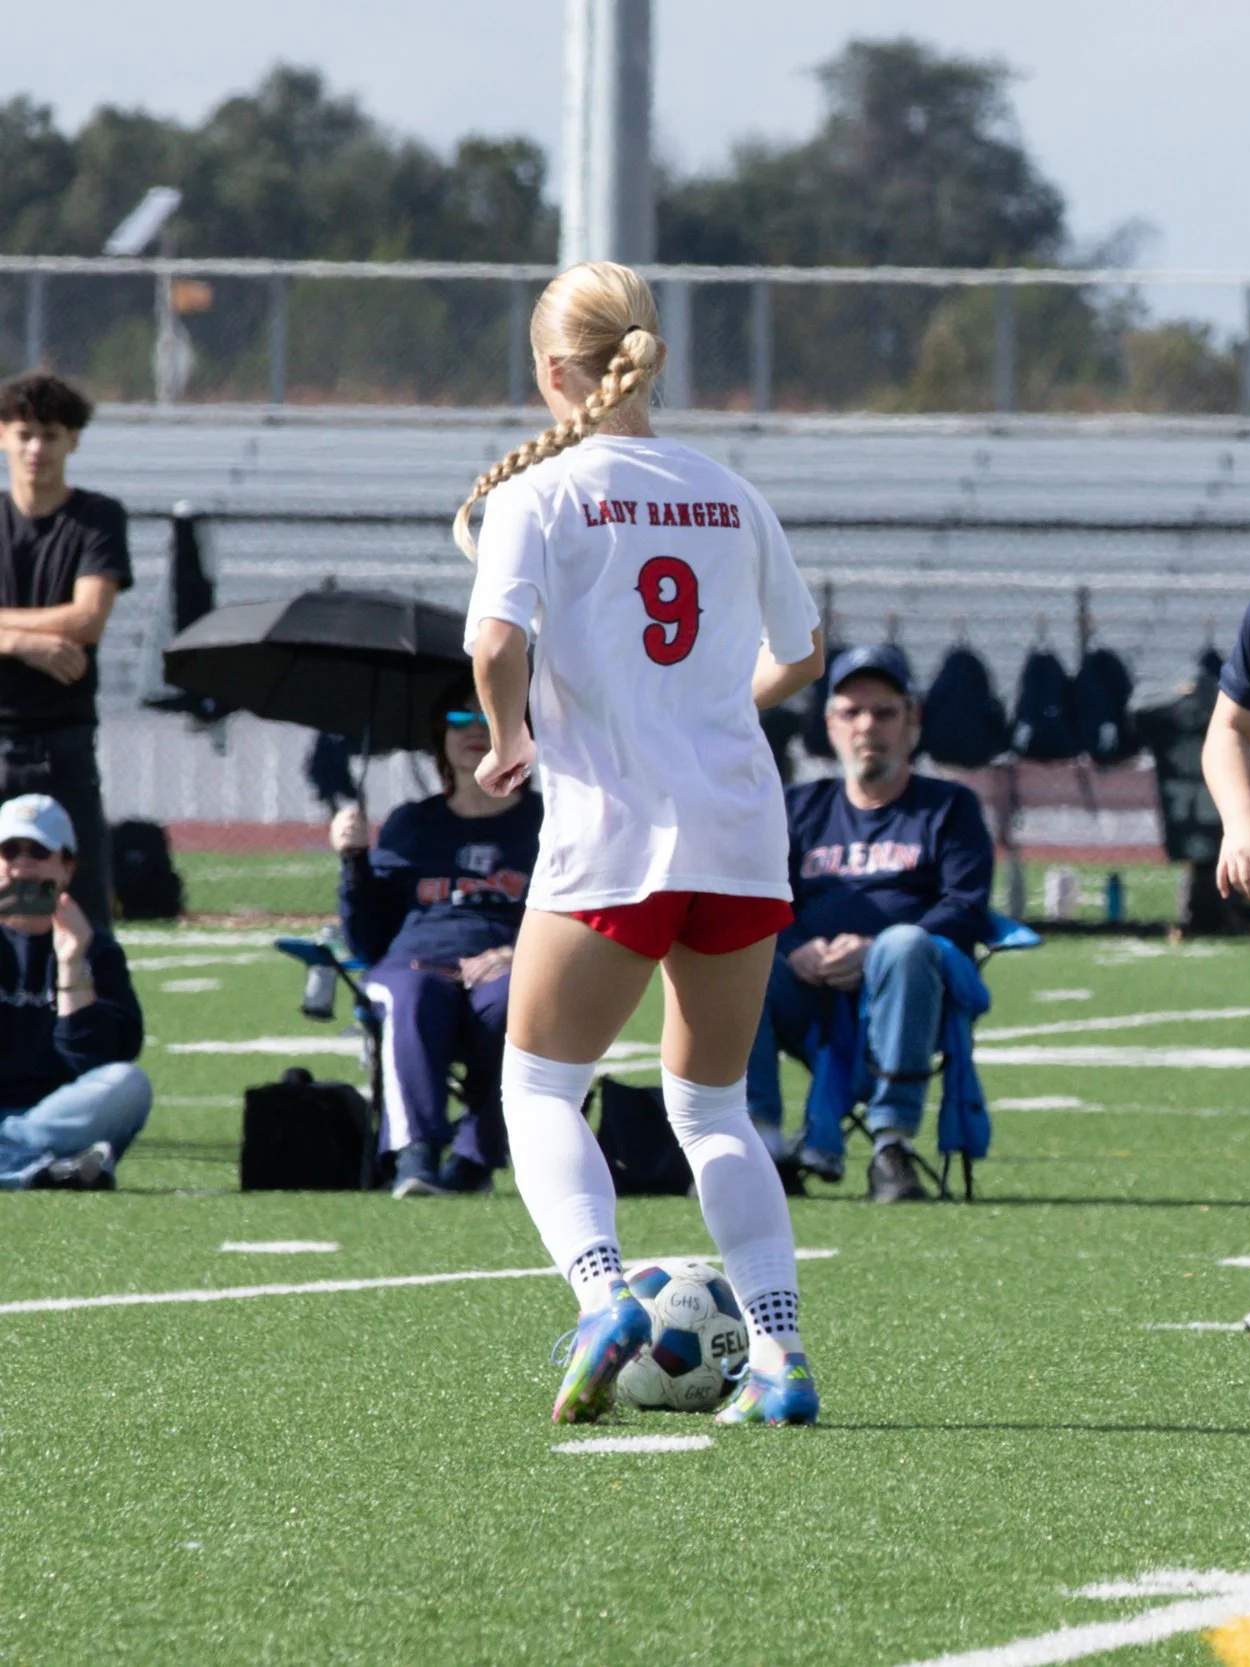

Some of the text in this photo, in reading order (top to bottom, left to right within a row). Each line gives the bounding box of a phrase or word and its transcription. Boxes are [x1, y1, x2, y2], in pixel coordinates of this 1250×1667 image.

[582, 500, 741, 529] LADY RANGERS
[634, 555, 704, 667] 9
[670, 1292, 701, 1312] GHS
